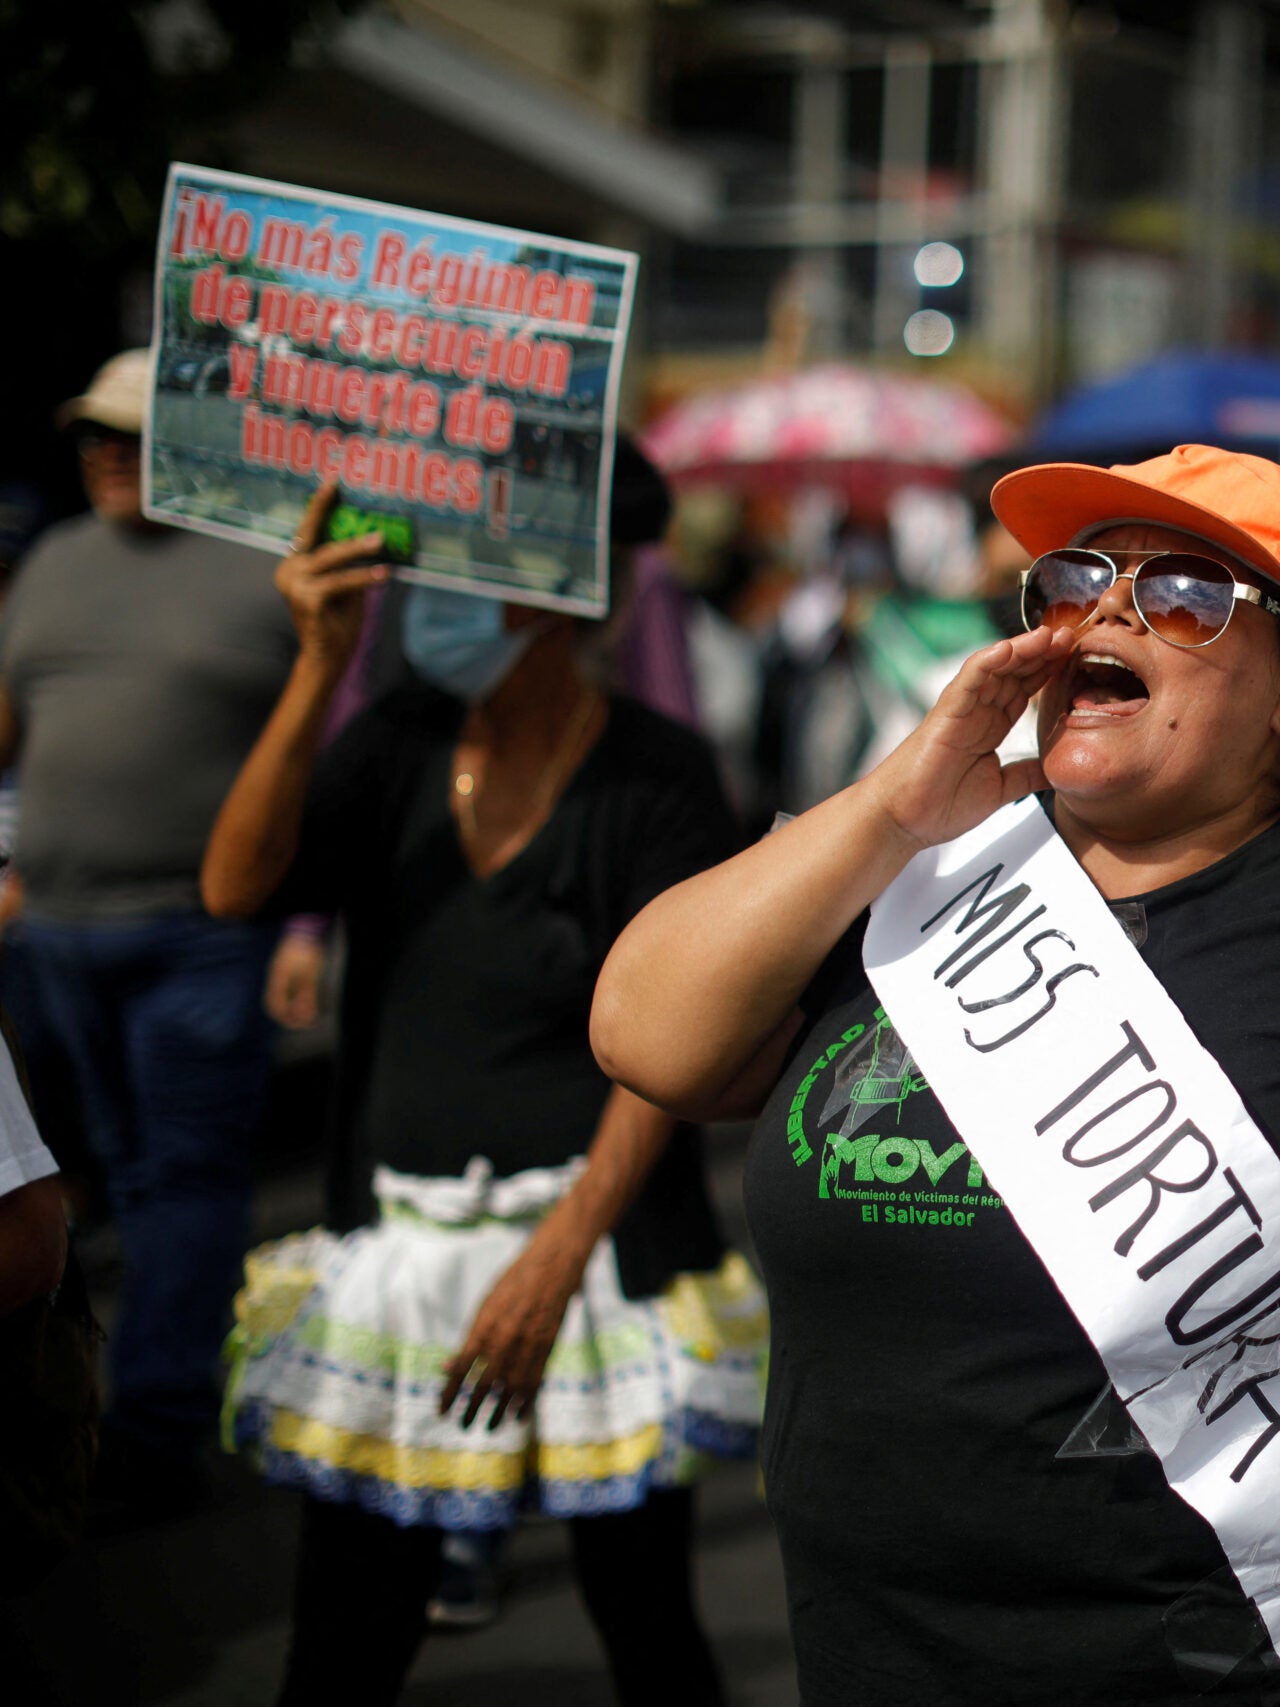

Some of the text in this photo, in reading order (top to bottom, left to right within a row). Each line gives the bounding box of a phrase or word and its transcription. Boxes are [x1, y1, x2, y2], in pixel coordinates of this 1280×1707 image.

[170, 186, 598, 330] ¡No más Régimen
[190, 260, 574, 398] de persecución
[226, 341, 517, 455] y muerte de
[241, 400, 485, 512] inocentes
[920, 862, 1101, 1054] MISS
[838, 1188, 897, 1202] Movimiento
[899, 1190, 912, 1202] de
[914, 1190, 960, 1204] Víctimas
[962, 1193, 979, 1206] del
[861, 1204, 977, 1228] El Salvador
